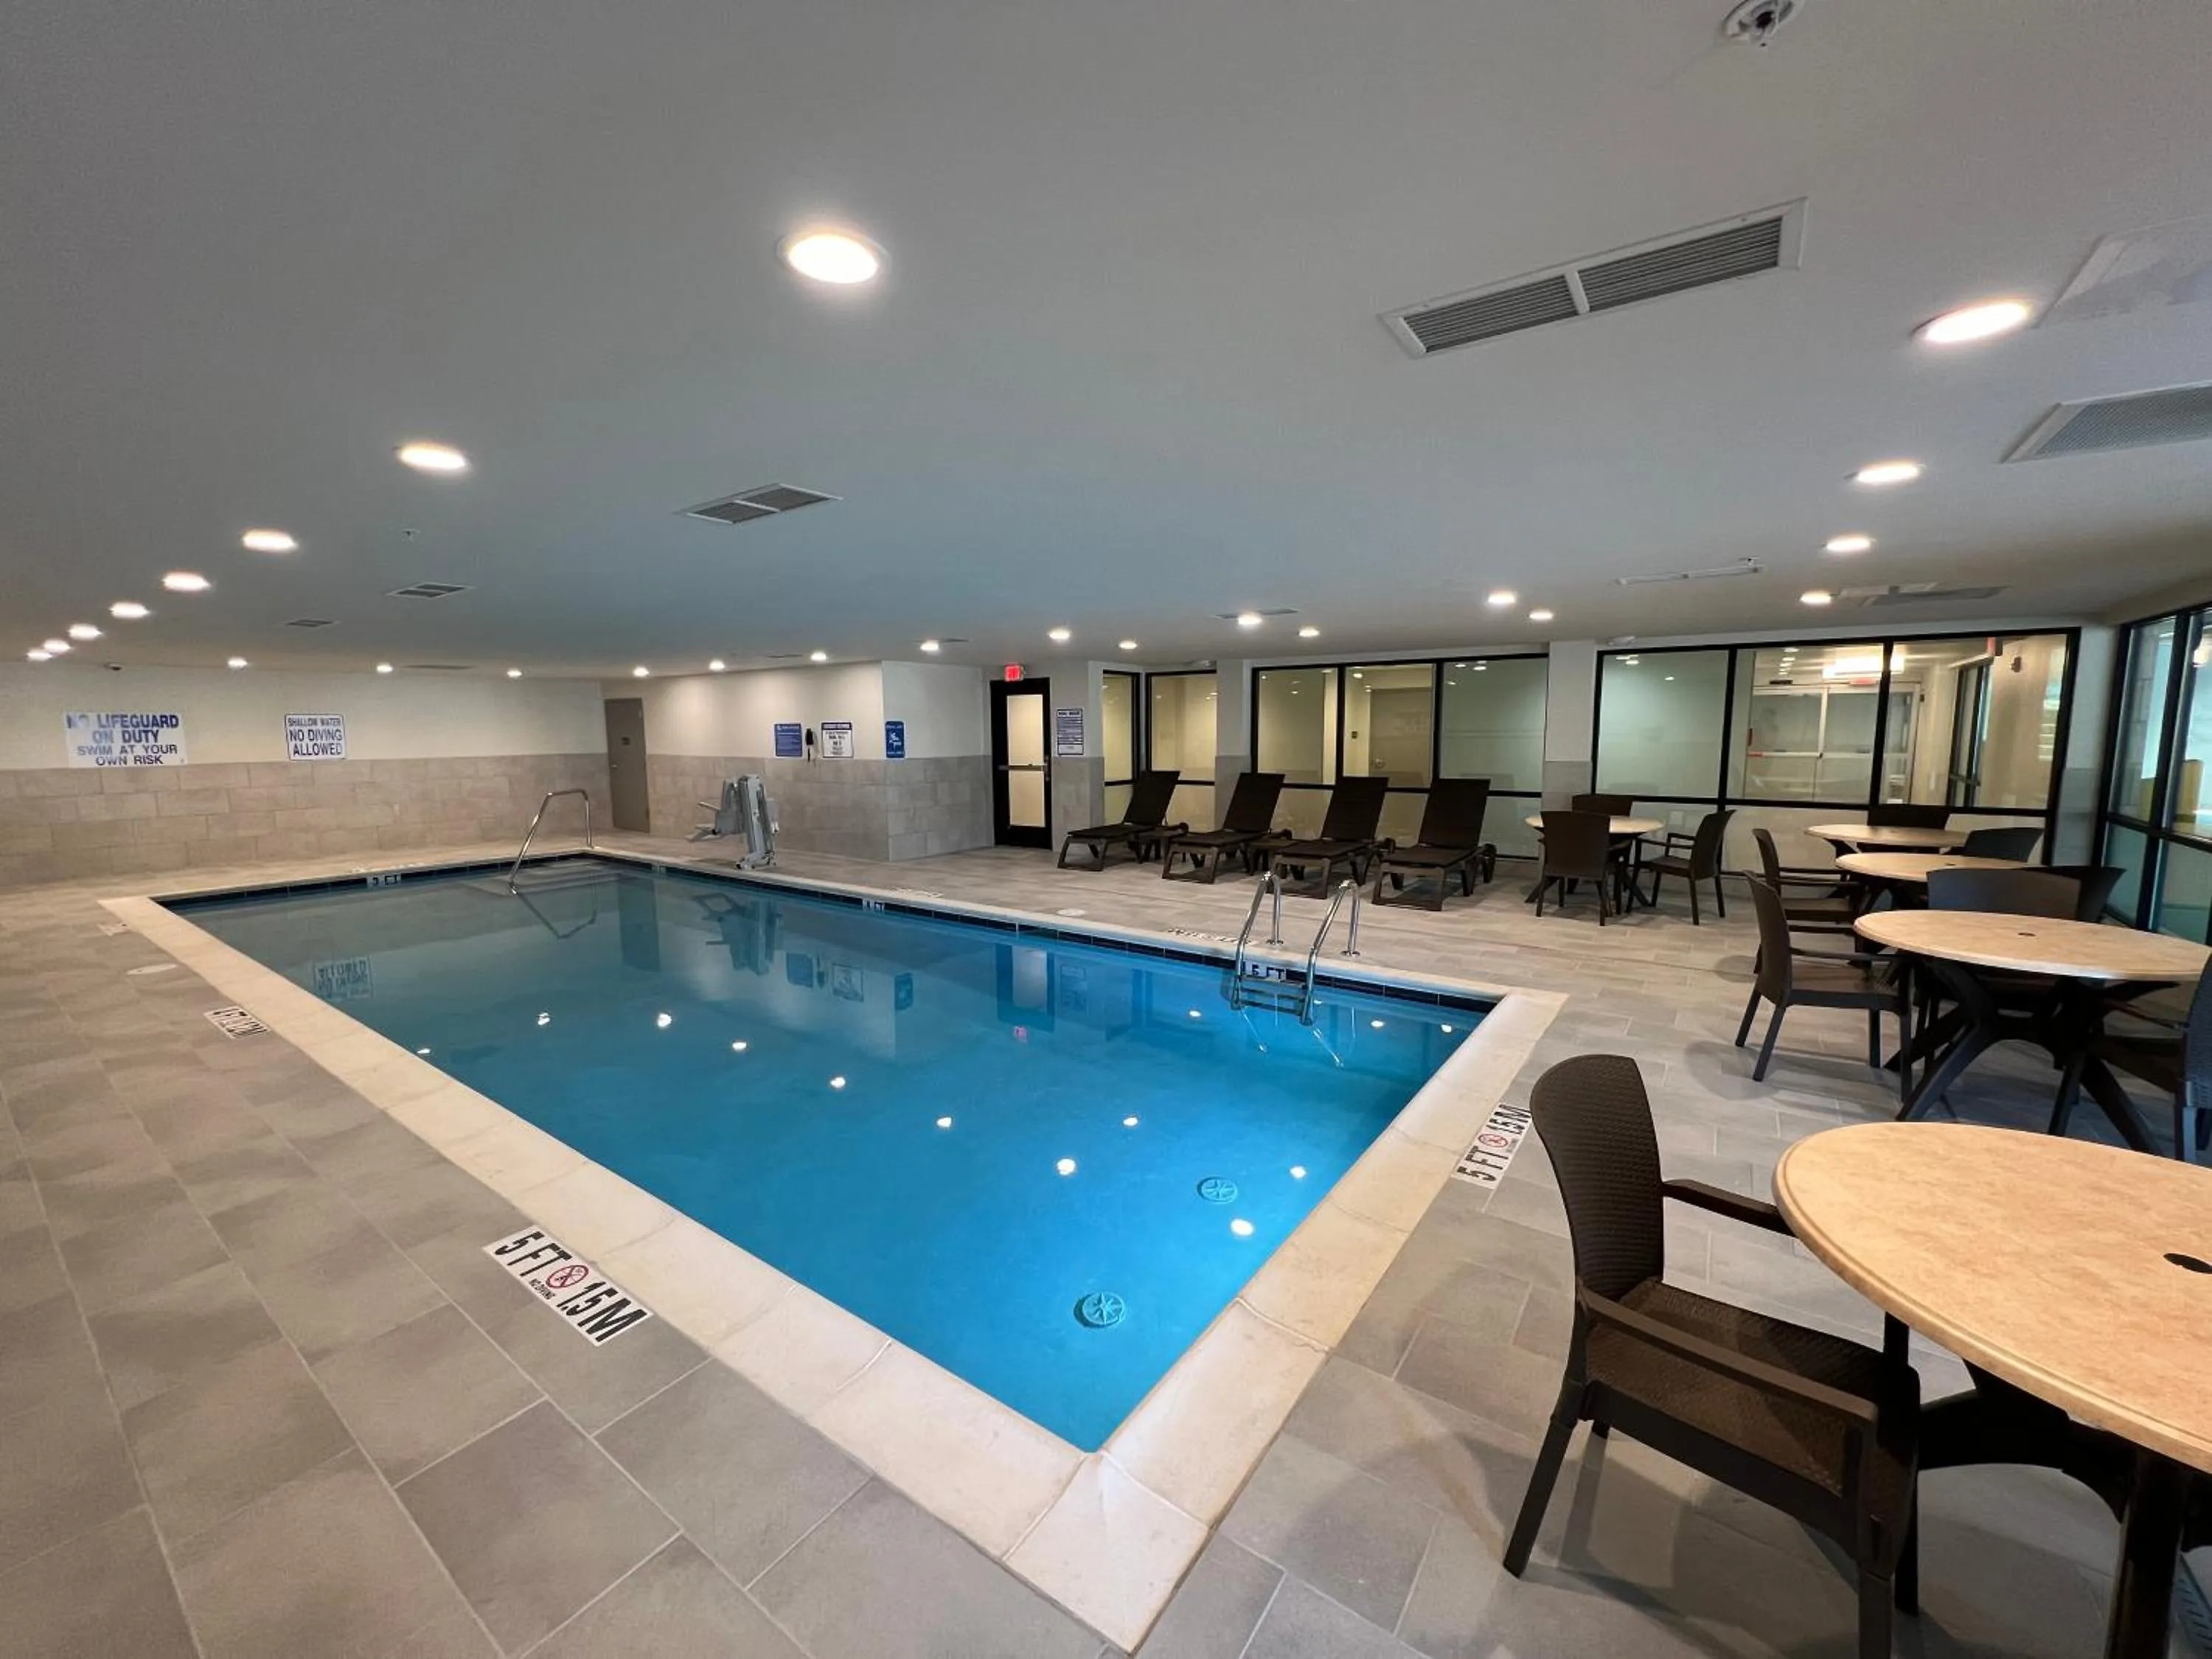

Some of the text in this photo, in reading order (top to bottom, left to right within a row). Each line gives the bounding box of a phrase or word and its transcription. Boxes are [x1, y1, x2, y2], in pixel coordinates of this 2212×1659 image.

[97, 714, 179, 728] LIFEGUARD
[92, 729, 160, 743] ON DUTY
[289, 728, 343, 742] NO DIVING
[77, 744, 178, 756] SWIM AT YOUR
[293, 742, 342, 756] ALLOWED
[95, 755, 164, 766] OWN RISK
[1266, 967, 1284, 979] FT
[1465, 1145, 1509, 1170] FT
[1456, 1166, 1496, 1181] 5
[494, 1231, 545, 1256] 5
[507, 1242, 573, 1276] FT
